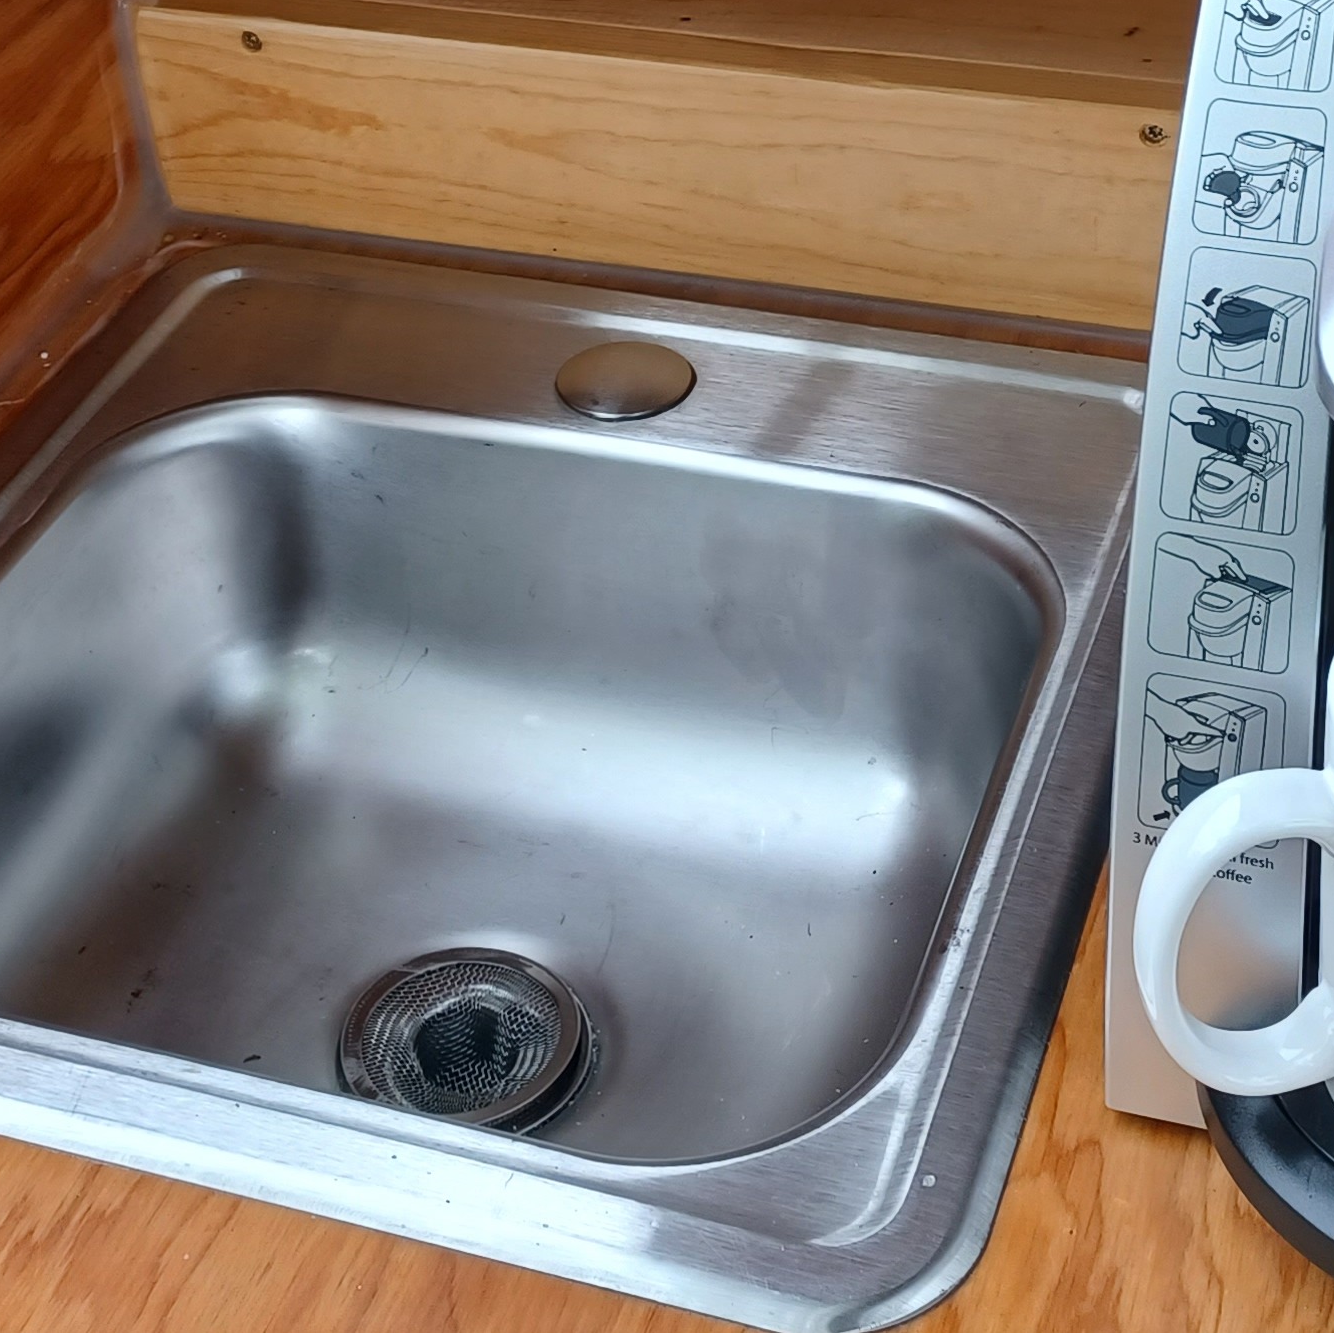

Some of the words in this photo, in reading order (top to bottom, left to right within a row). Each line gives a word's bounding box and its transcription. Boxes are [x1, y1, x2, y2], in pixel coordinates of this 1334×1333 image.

[1132, 832, 1141, 844] 3
[1239, 852, 1275, 870] fresh
[1212, 868, 1253, 884] offee
